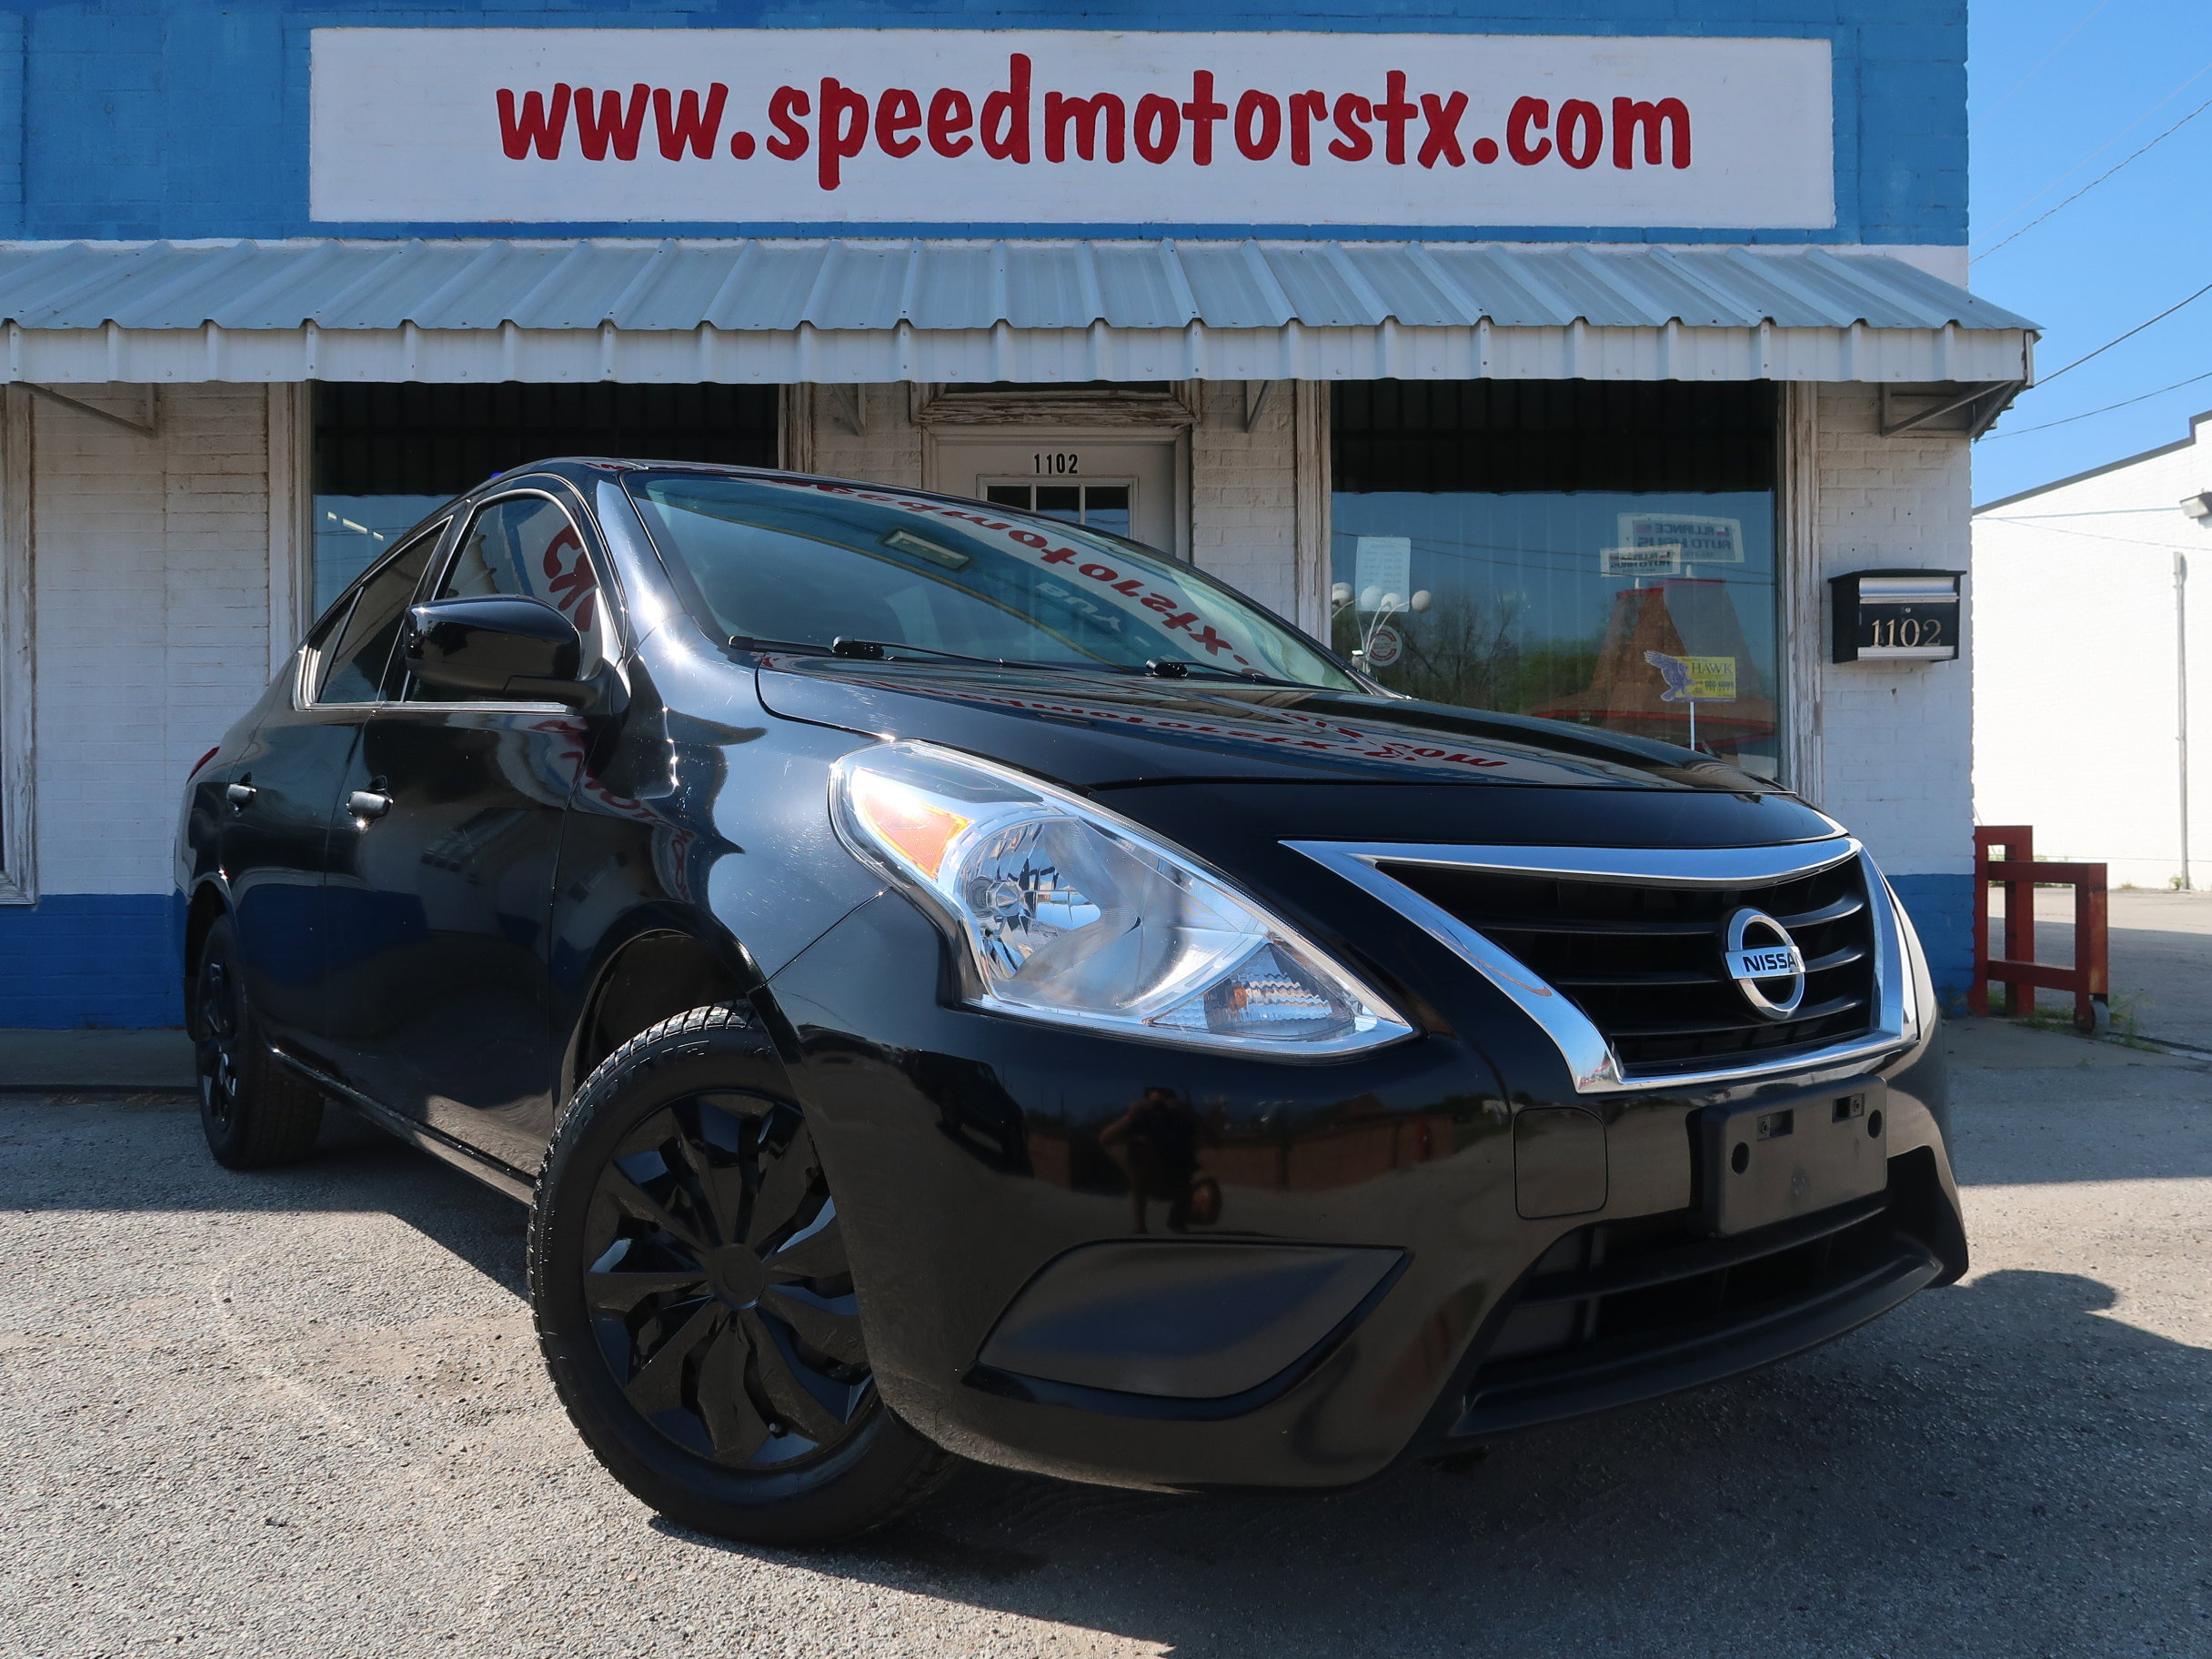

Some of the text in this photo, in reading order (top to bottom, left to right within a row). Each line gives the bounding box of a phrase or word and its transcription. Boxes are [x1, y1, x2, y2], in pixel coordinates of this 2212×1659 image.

[498, 54, 1691, 190] www.speedmotorstx.com
[1034, 453, 1078, 474] 1102
[1870, 618, 1942, 648] 1102
[1692, 662, 1733, 674] HAWK
